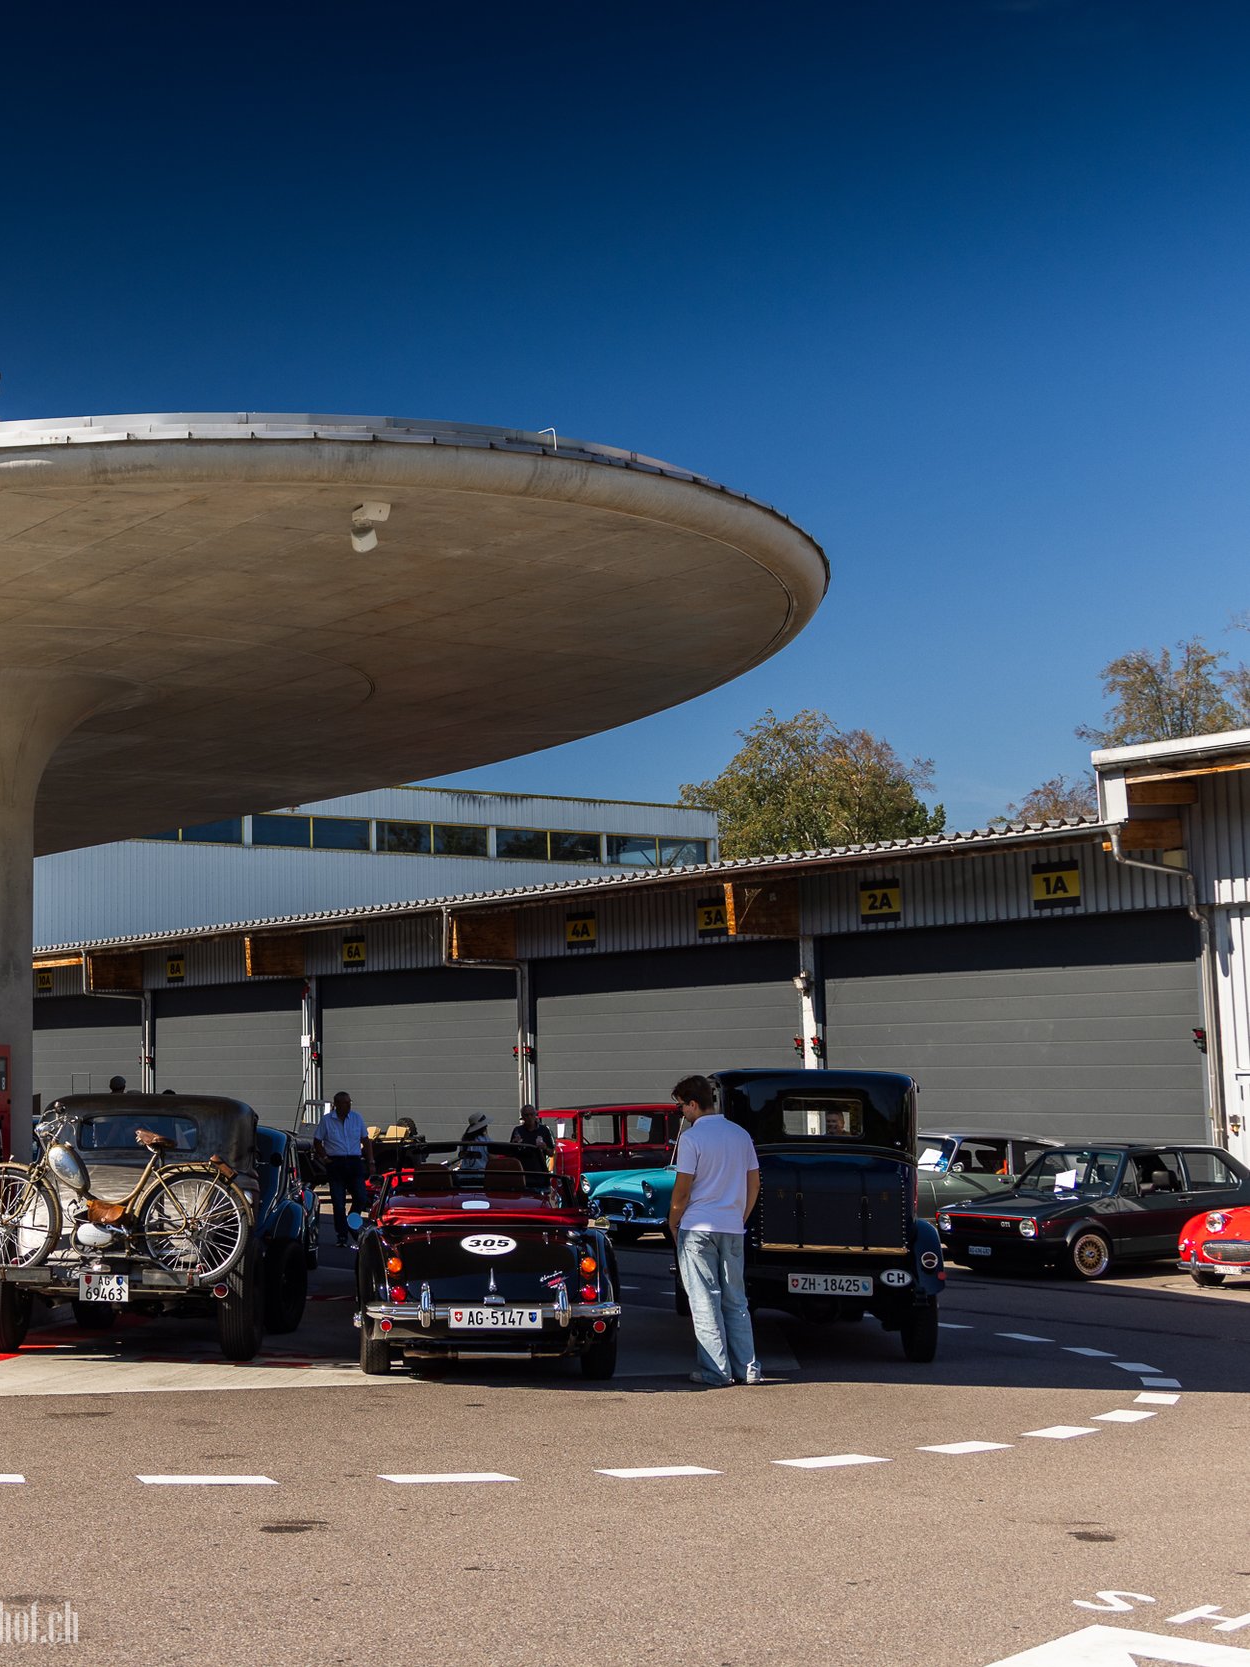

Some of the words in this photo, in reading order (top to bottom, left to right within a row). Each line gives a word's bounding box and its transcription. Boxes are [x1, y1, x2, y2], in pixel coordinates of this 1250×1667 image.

[1042, 876, 1068, 895] 1A
[867, 893, 893, 910] 2A
[704, 909, 725, 926] 3A
[571, 923, 591, 938] 4A
[346, 945, 361, 959] 6A
[170, 962, 181, 975] 8A
[39, 975, 51, 986] 10A
[468, 1238, 510, 1248] 305
[98, 1275, 110, 1286] AG
[886, 1272, 906, 1284] CH
[85, 1286, 123, 1301] 69463
